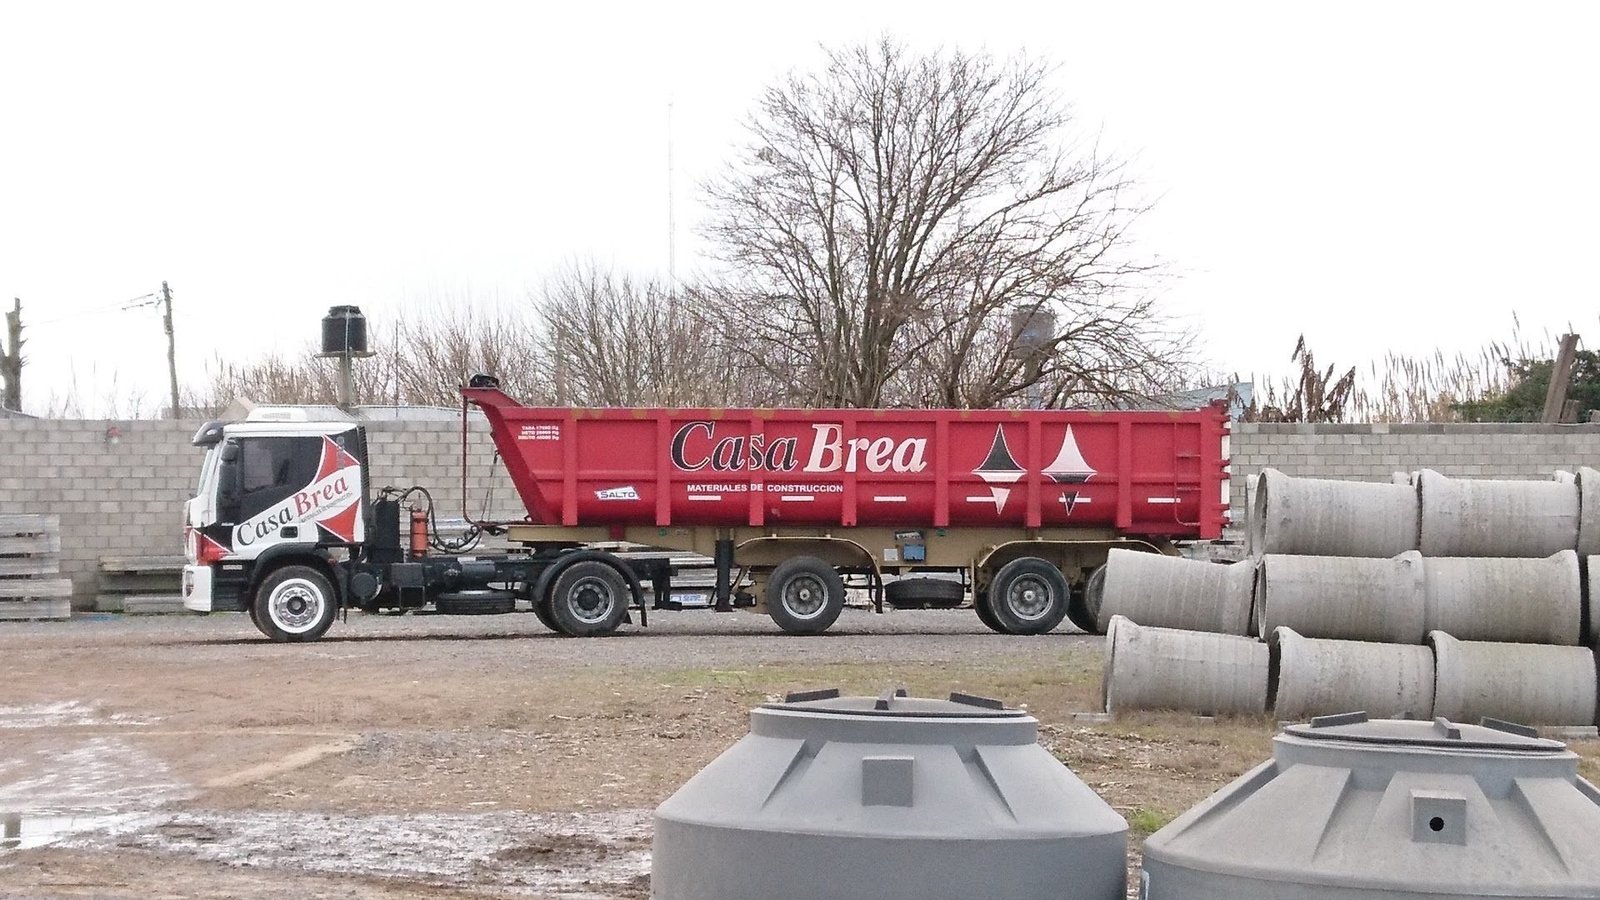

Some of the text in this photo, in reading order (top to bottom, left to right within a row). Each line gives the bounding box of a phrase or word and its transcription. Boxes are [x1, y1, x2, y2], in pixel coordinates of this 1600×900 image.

[670, 421, 928, 473] Casa Brea
[237, 505, 293, 546] Casa
[292, 476, 349, 517] Brea
[687, 483, 843, 493] MATERIALES DE CONSTRUCCION
